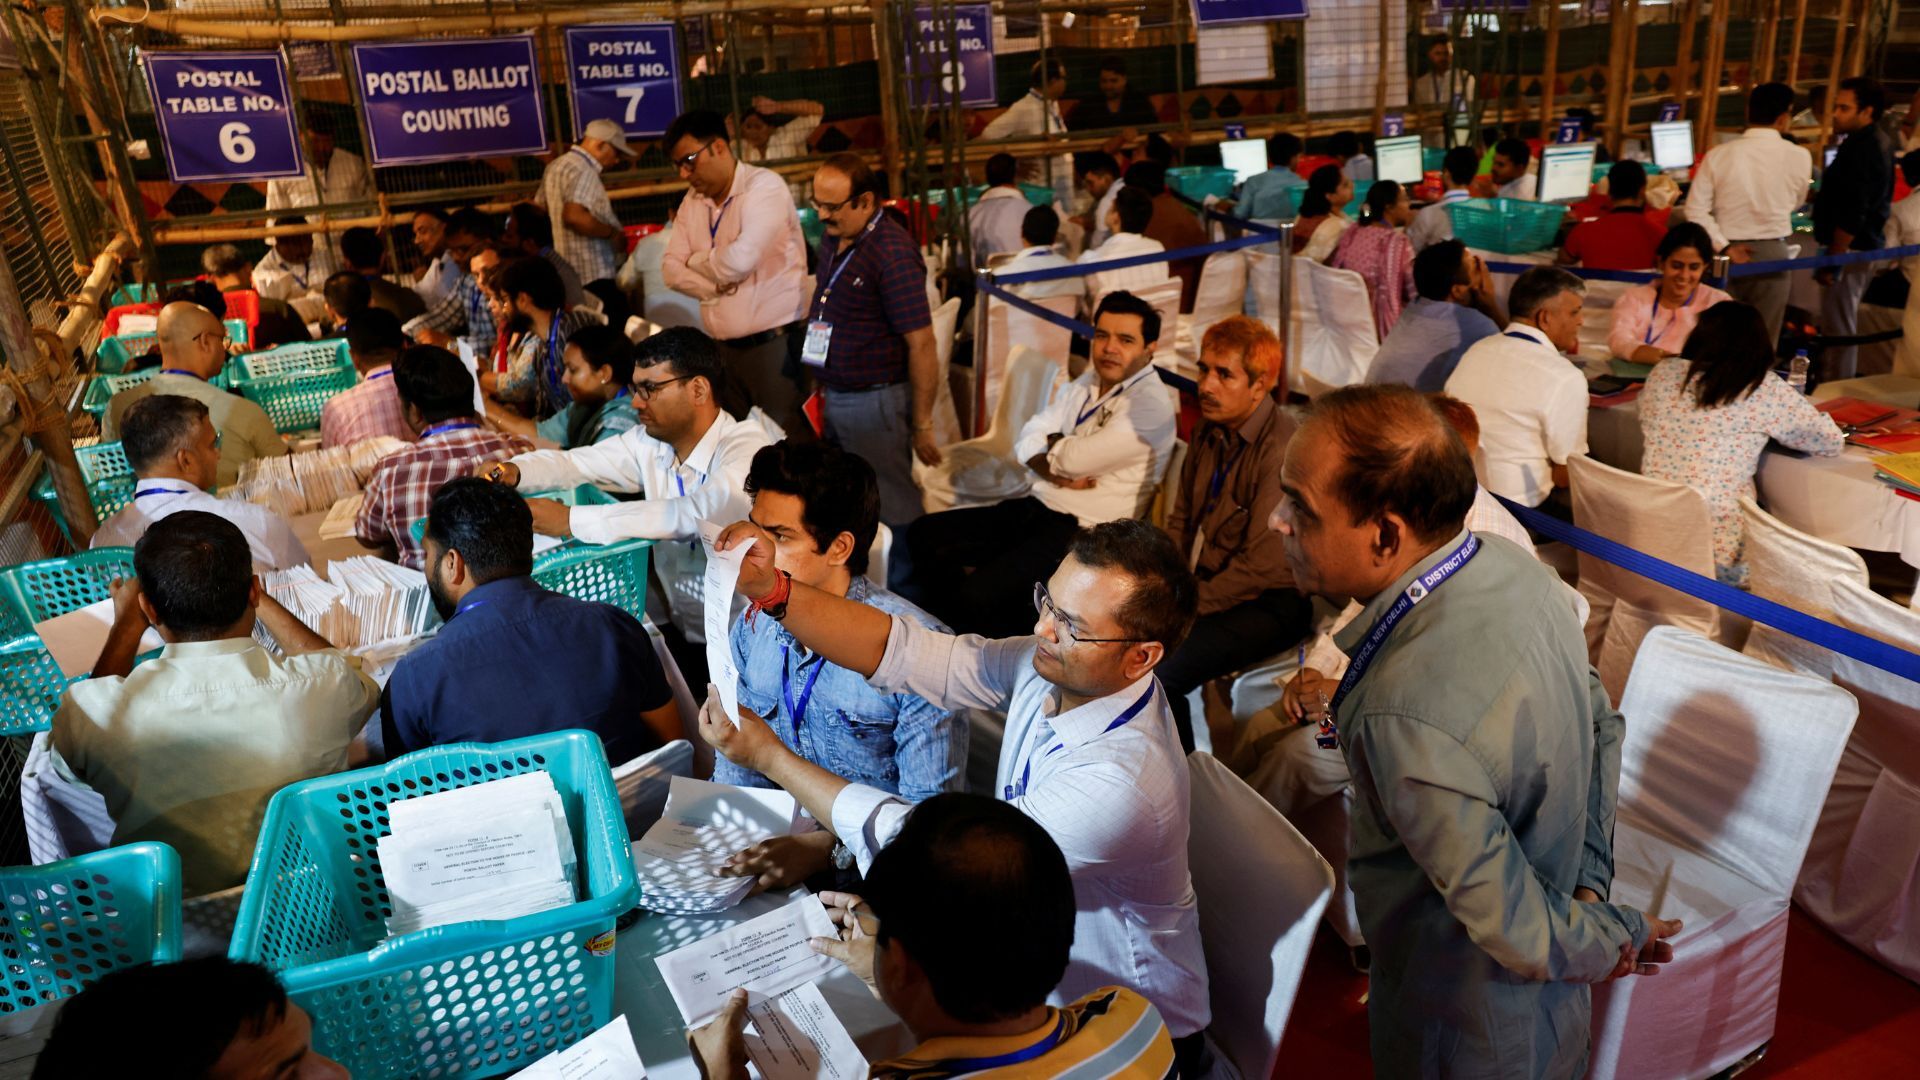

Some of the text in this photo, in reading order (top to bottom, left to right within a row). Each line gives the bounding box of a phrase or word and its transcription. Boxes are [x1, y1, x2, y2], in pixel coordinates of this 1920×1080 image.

[588, 41, 656, 57] POSTAL
[959, 38, 985, 51] NO.
[176, 70, 262, 88] POSTAL
[366, 65, 530, 97] POSTAL BALLOT
[578, 63, 670, 80] TABLE NO.
[942, 60, 966, 93] 8
[166, 95, 281, 114] TABLE NO.
[616, 87, 645, 123] 7
[401, 104, 511, 134] COUNTING
[1389, 124, 1399, 136] 2
[219, 121, 256, 164] 6
[1563, 127, 1573, 142] 3
[1424, 554, 1462, 586] DISTRICT
[1354, 641, 1375, 671] OFFICE,
[1372, 623, 1388, 642] NEW
[1386, 598, 1407, 625] DELHI
